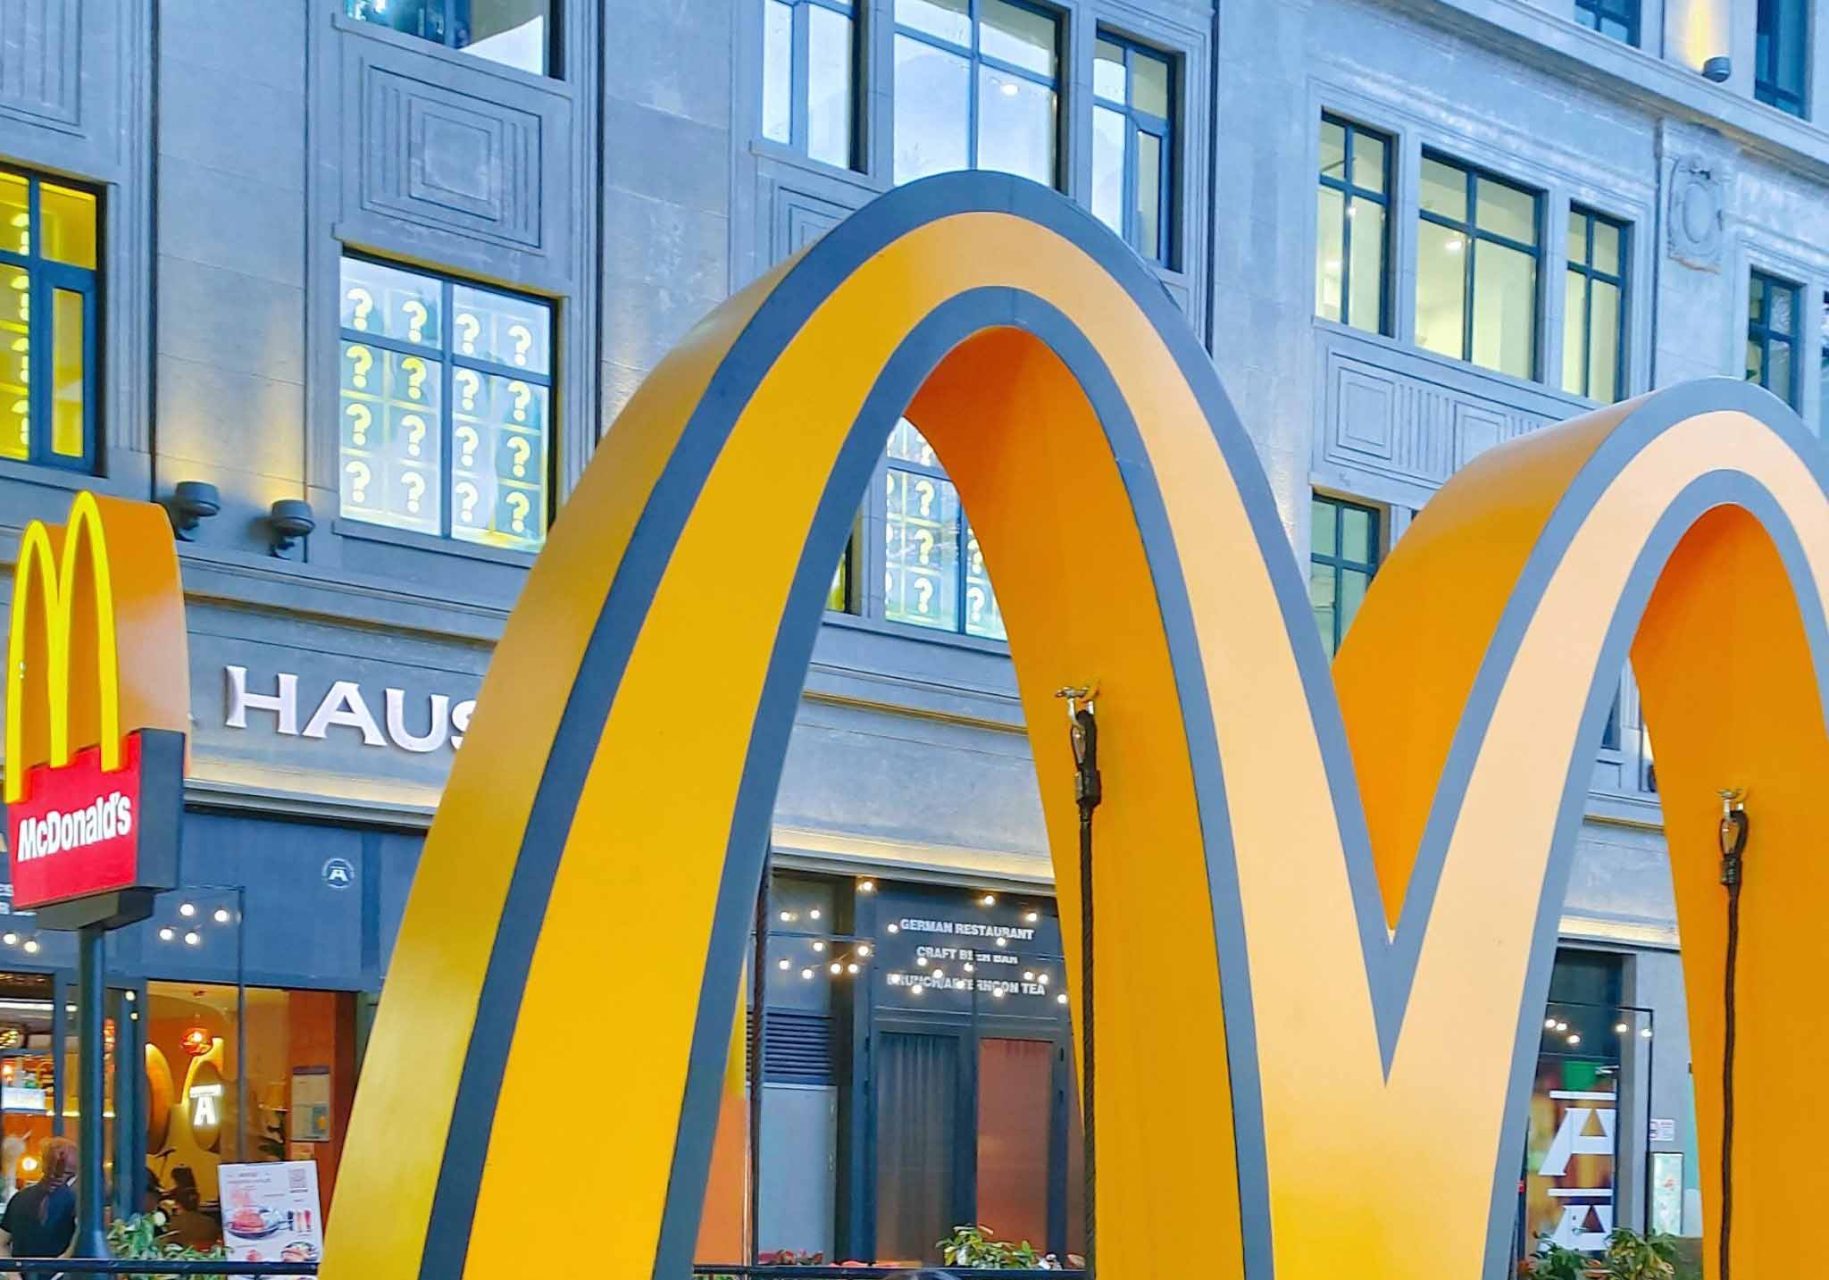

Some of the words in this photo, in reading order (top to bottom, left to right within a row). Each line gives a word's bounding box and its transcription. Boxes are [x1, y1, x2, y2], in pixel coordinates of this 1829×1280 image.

[17, 791, 131, 862] McDonald's
[901, 919, 953, 934] GERMAN
[955, 923, 1035, 940] RESTAURANT
[916, 946, 957, 960] CRAFT
[1020, 982, 1046, 996] TEA
